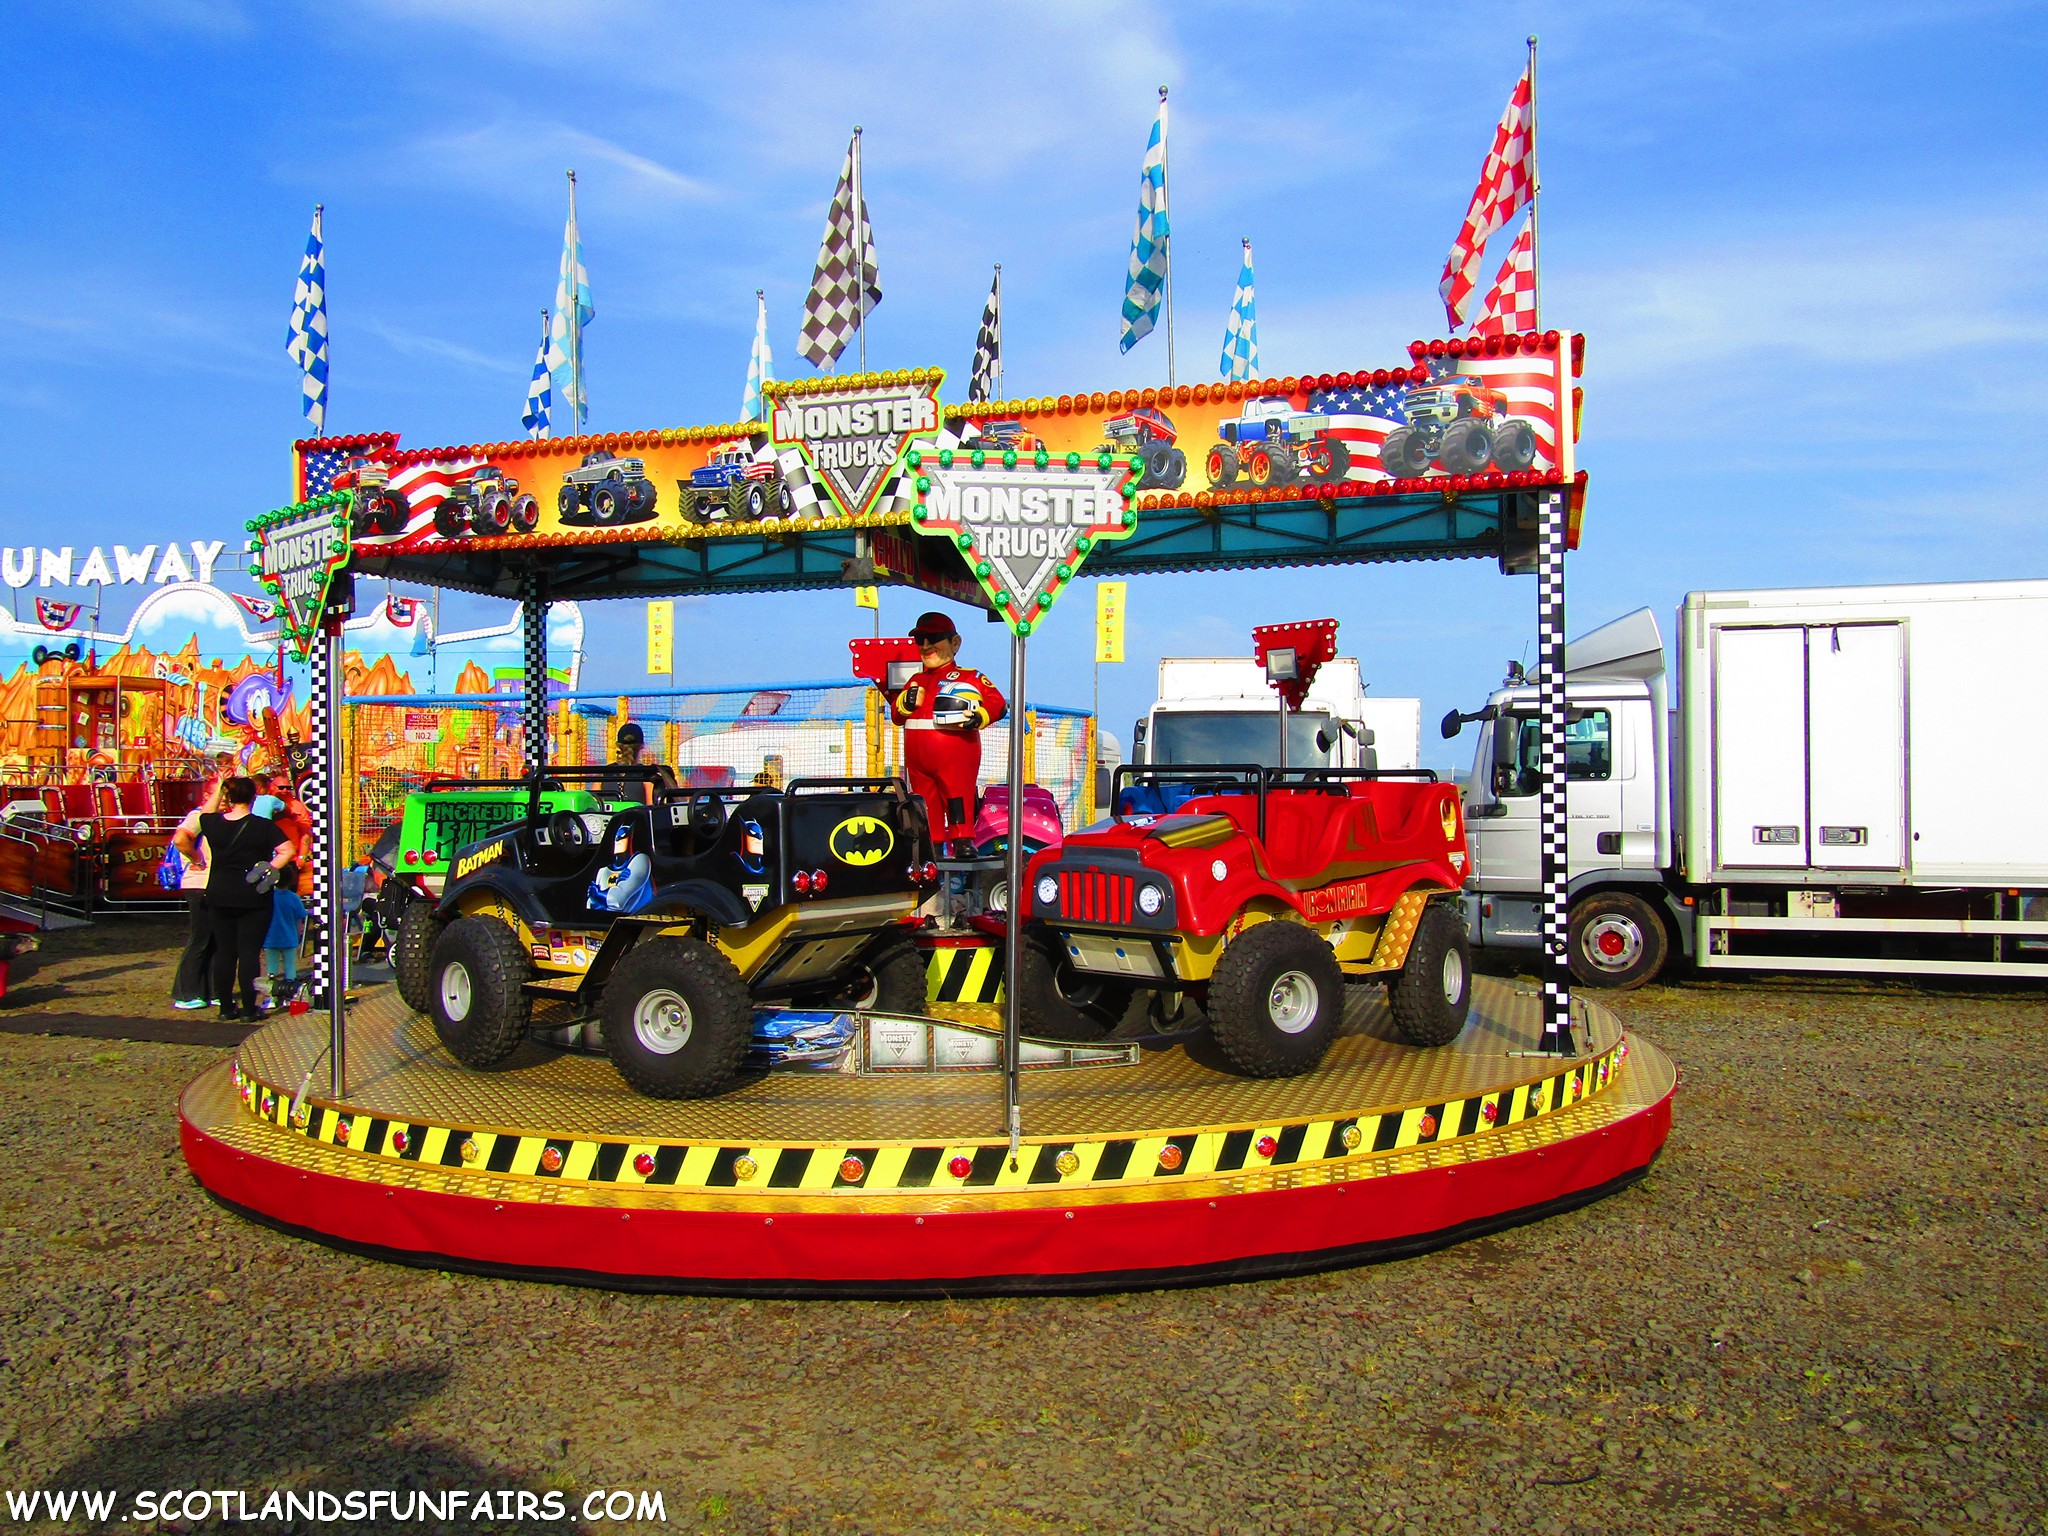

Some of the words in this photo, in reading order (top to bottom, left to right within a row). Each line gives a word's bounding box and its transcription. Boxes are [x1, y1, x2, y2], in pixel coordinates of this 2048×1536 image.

[776, 397, 936, 441] MONSTER
[808, 438, 898, 470] TRUCKS
[924, 485, 1124, 525] MONSTER
[974, 526, 1067, 559] TRUCK
[433, 802, 554, 822] INCREDIBE
[456, 839, 505, 879] BATMAN
[1303, 888, 1337, 917] IRON
[1337, 882, 1368, 911] MAN
